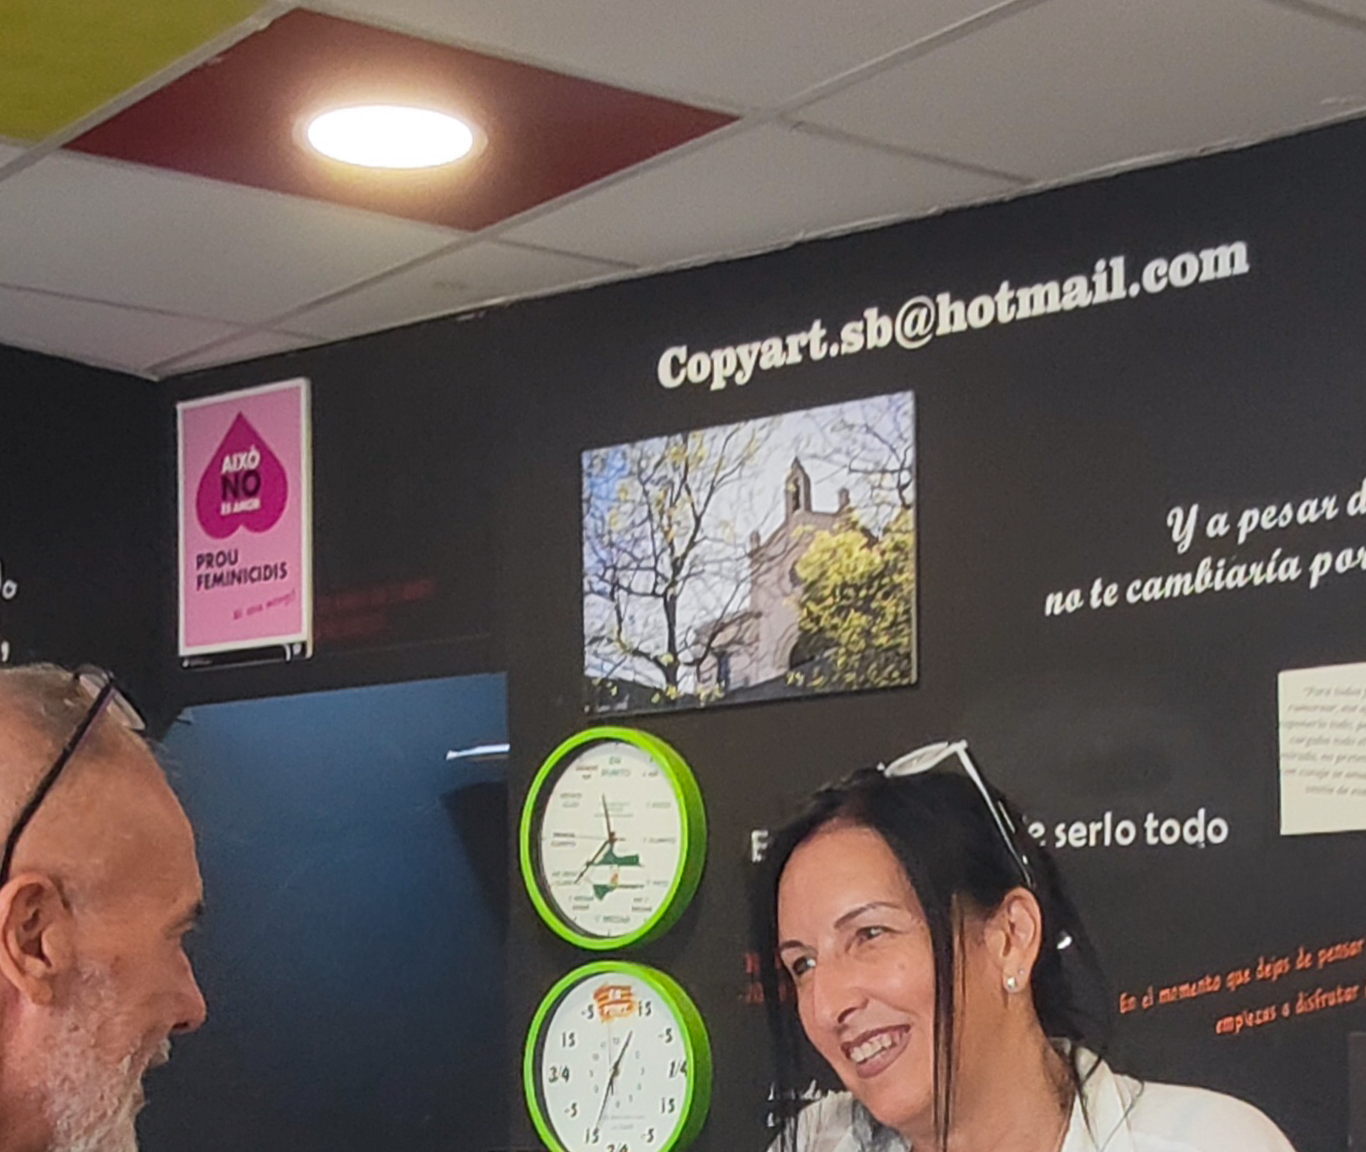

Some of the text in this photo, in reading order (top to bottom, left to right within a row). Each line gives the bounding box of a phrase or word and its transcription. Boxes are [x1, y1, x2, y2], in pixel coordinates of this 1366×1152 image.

[657, 240, 1249, 390] Copyart.sb@hotmail.com
[221, 469, 262, 501] NO
[1237, 493, 1339, 543] pesar
[196, 549, 239, 571] PROU
[196, 562, 288, 591] FEMINICIDIS
[1045, 588, 1083, 616] no
[1091, 578, 1119, 608] te
[1126, 548, 1303, 604] cambiaría
[1055, 811, 1135, 849] serlo
[1144, 808, 1229, 849] todo
[1119, 993, 1136, 1015] En
[1142, 987, 1153, 1009] el
[1159, 973, 1221, 1004] momento
[1227, 968, 1251, 992] que
[1295, 948, 1313, 970] de
[1296, 983, 1359, 1017] disfrutar
